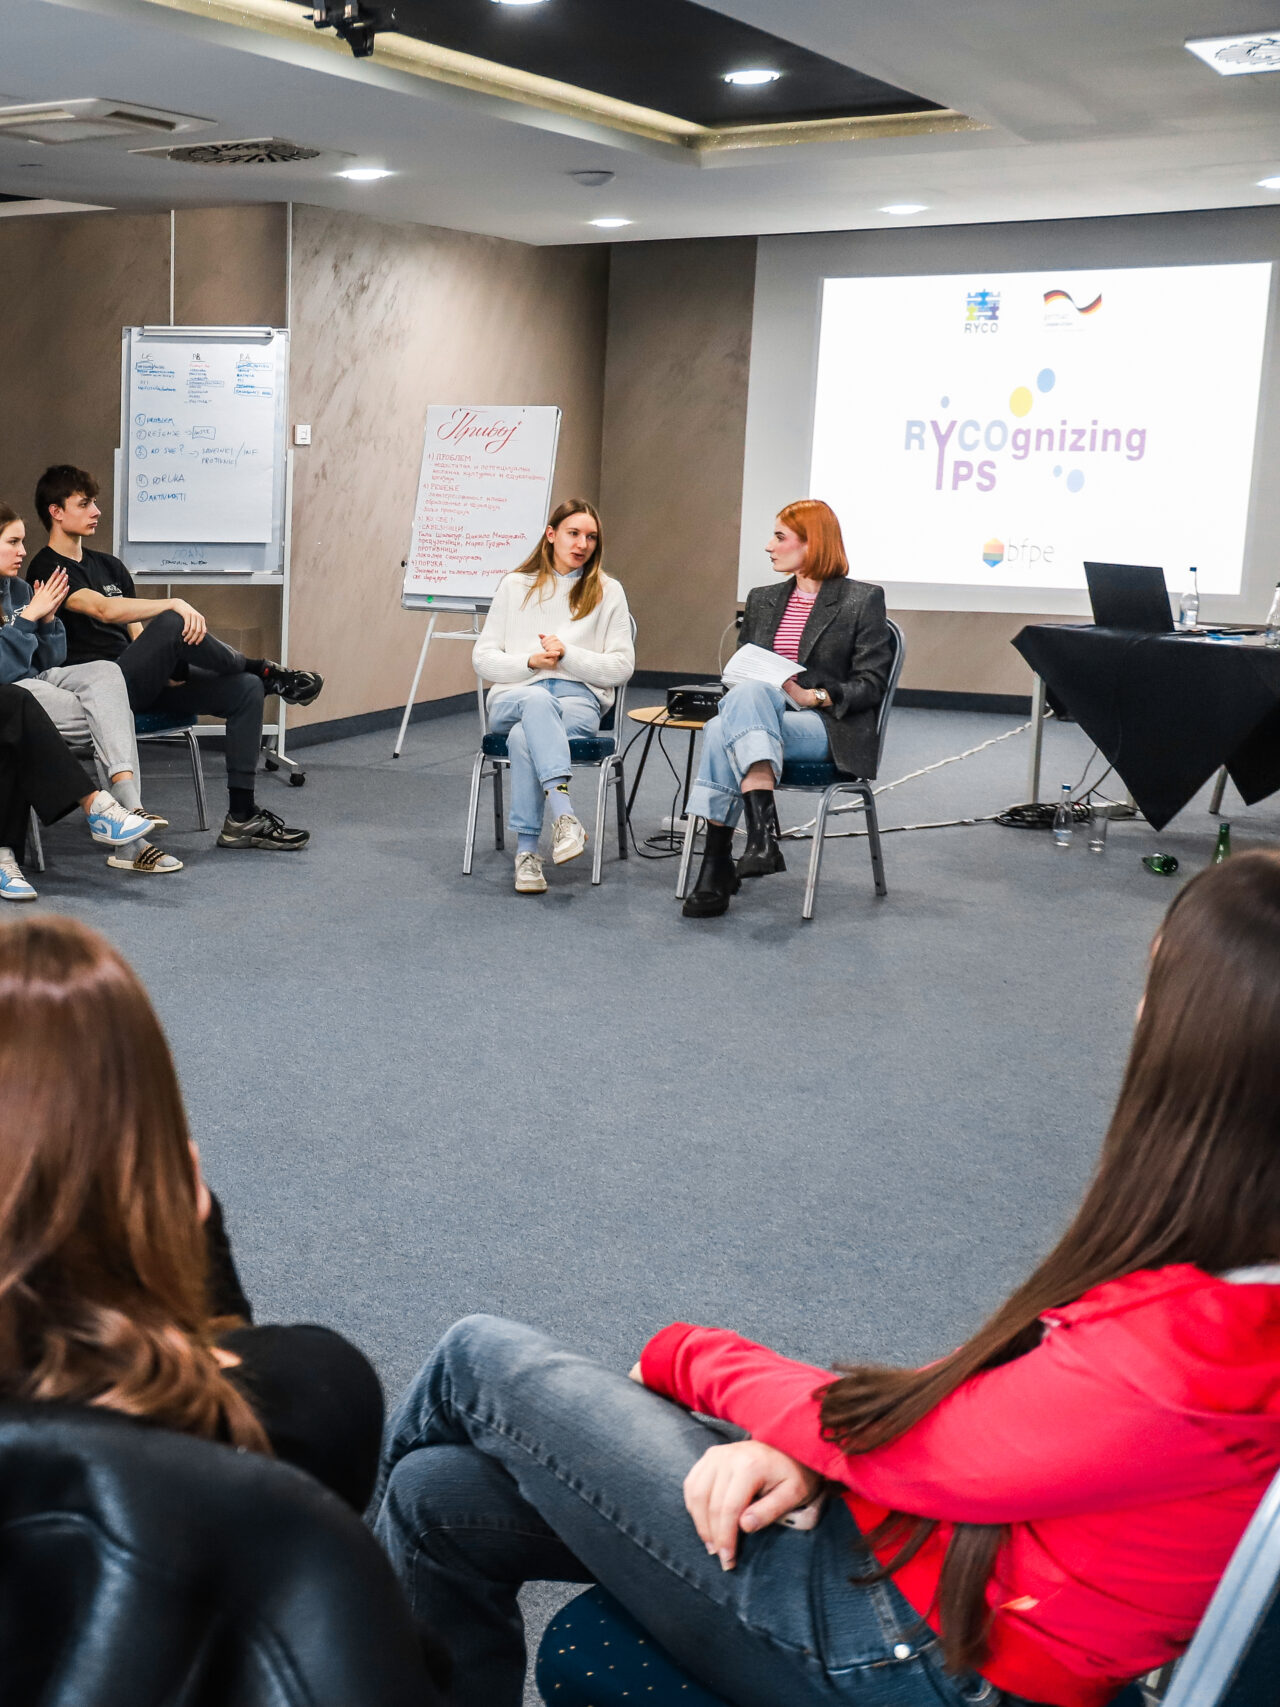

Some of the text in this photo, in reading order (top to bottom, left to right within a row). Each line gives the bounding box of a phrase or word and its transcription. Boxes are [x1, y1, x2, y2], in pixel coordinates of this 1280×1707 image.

[964, 322, 999, 333] RYCO
[904, 418, 1147, 462] RYCOgnizing
[436, 453, 472, 462] ПРОБЛЕМ
[1007, 537, 1055, 568] bfpe
